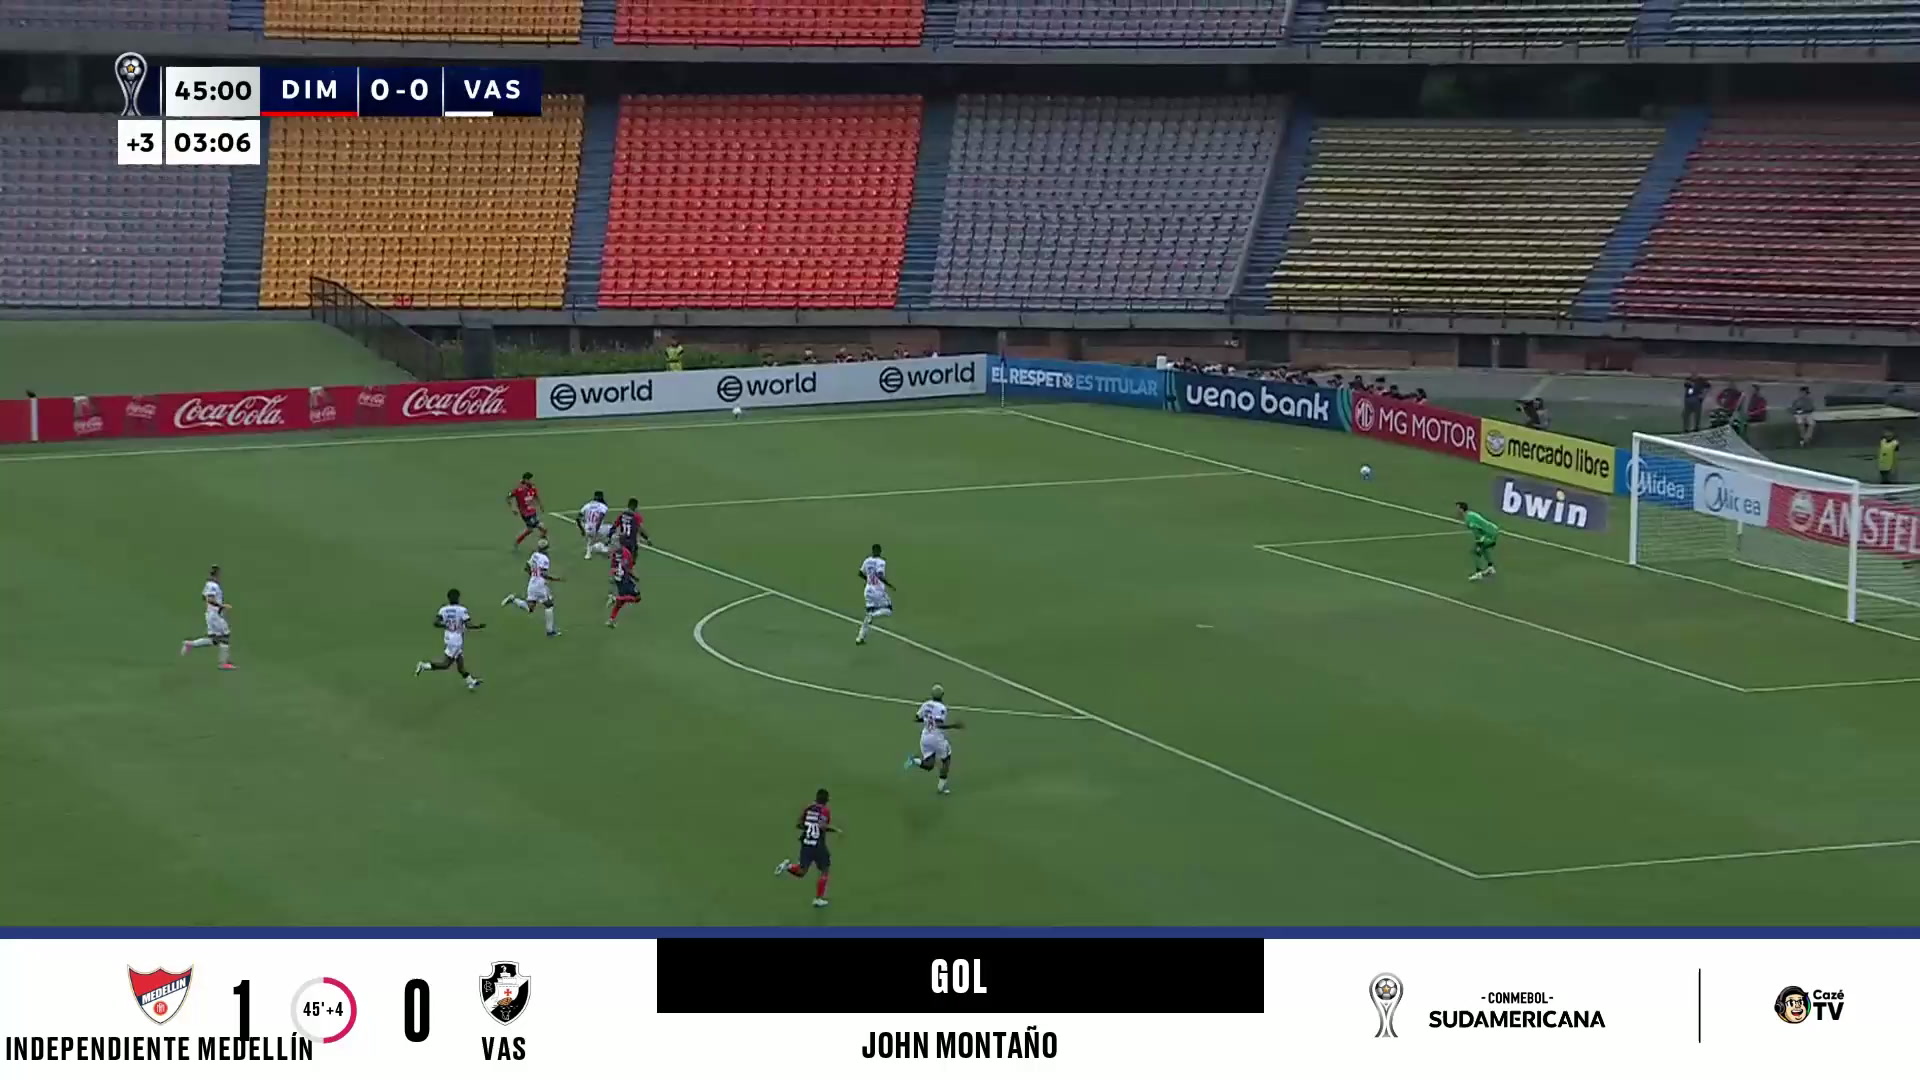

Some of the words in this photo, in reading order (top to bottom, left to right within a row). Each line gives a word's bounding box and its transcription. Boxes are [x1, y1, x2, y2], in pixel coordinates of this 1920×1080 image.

[746, 371, 817, 396] world
[907, 362, 976, 387] world
[992, 366, 1008, 383] EL
[1075, 375, 1093, 390] ES
[1095, 375, 1158, 396] TITULAR
[402, 385, 510, 417] Coca-Cola
[580, 379, 653, 405] world
[1186, 384, 1256, 415] ueno
[1261, 390, 1330, 422] bank
[174, 394, 287, 429] Coca-Cola
[1379, 411, 1407, 436] MG
[1410, 415, 1477, 451] MOTOR
[1507, 438, 1572, 470] mercado
[1573, 448, 1610, 479] libre
[1501, 480, 1588, 528] bwin
[804, 821, 820, 839] 70
